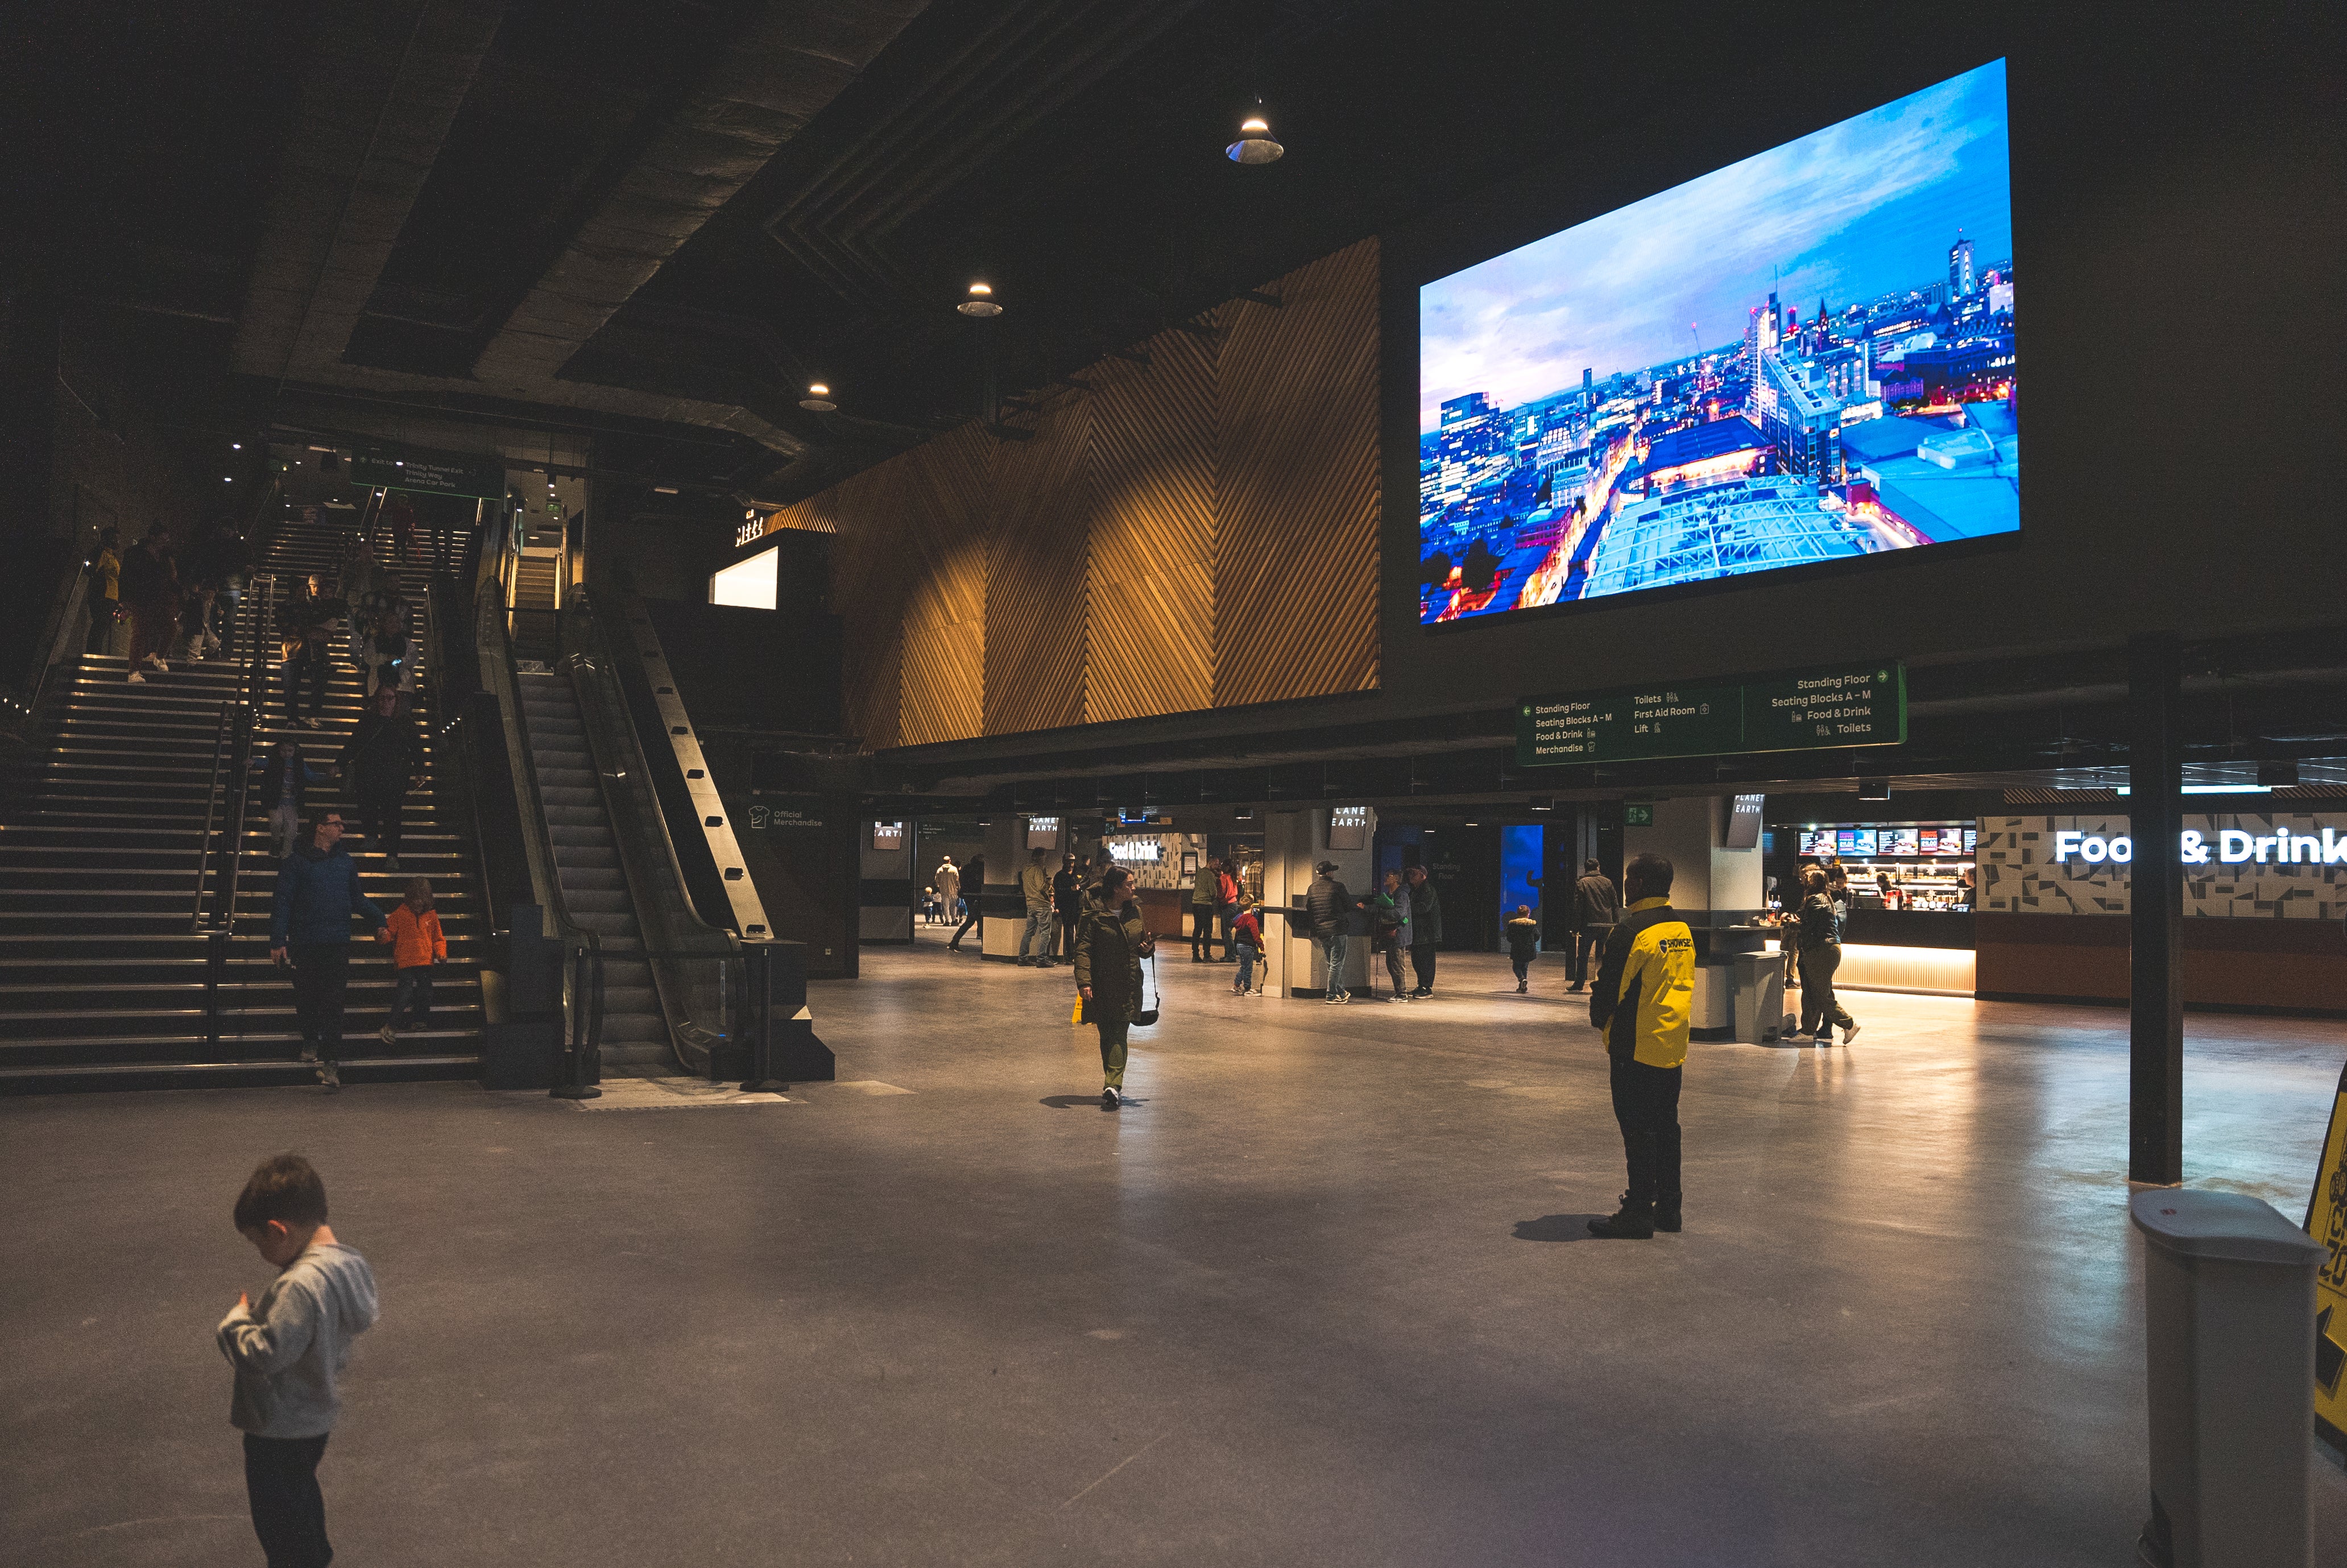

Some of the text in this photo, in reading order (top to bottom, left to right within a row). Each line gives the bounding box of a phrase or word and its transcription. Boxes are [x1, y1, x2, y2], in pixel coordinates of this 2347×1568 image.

[405, 462, 427, 470] Trinity
[1798, 675, 1870, 689] Standing Floor
[1634, 695, 1662, 705] Toilets
[1771, 696, 1808, 707] Seating
[1810, 693, 1843, 704] Blocks
[1845, 692, 1852, 701] A
[1862, 690, 1871, 699] M
[1536, 702, 1590, 714] Standing Floor
[1634, 707, 1695, 719] First Aid Room
[1807, 706, 1871, 719] Food & Drink
[1536, 718, 1564, 727] Seating
[1566, 715, 1591, 725] Blocks
[1634, 724, 1649, 733] Lift
[1837, 723, 1872, 734] Toilets
[1536, 732, 1554, 740] Food
[1563, 730, 1583, 739] Drink
[1536, 744, 1583, 754] Merchandise
[1736, 804, 1761, 813] EARTH
[773, 818, 822, 827] Merchandise
[1109, 841, 1128, 860] Food
[1135, 841, 1160, 860] Drink
[2181, 829, 2209, 863] &
[1433, 863, 1460, 872] Standing
